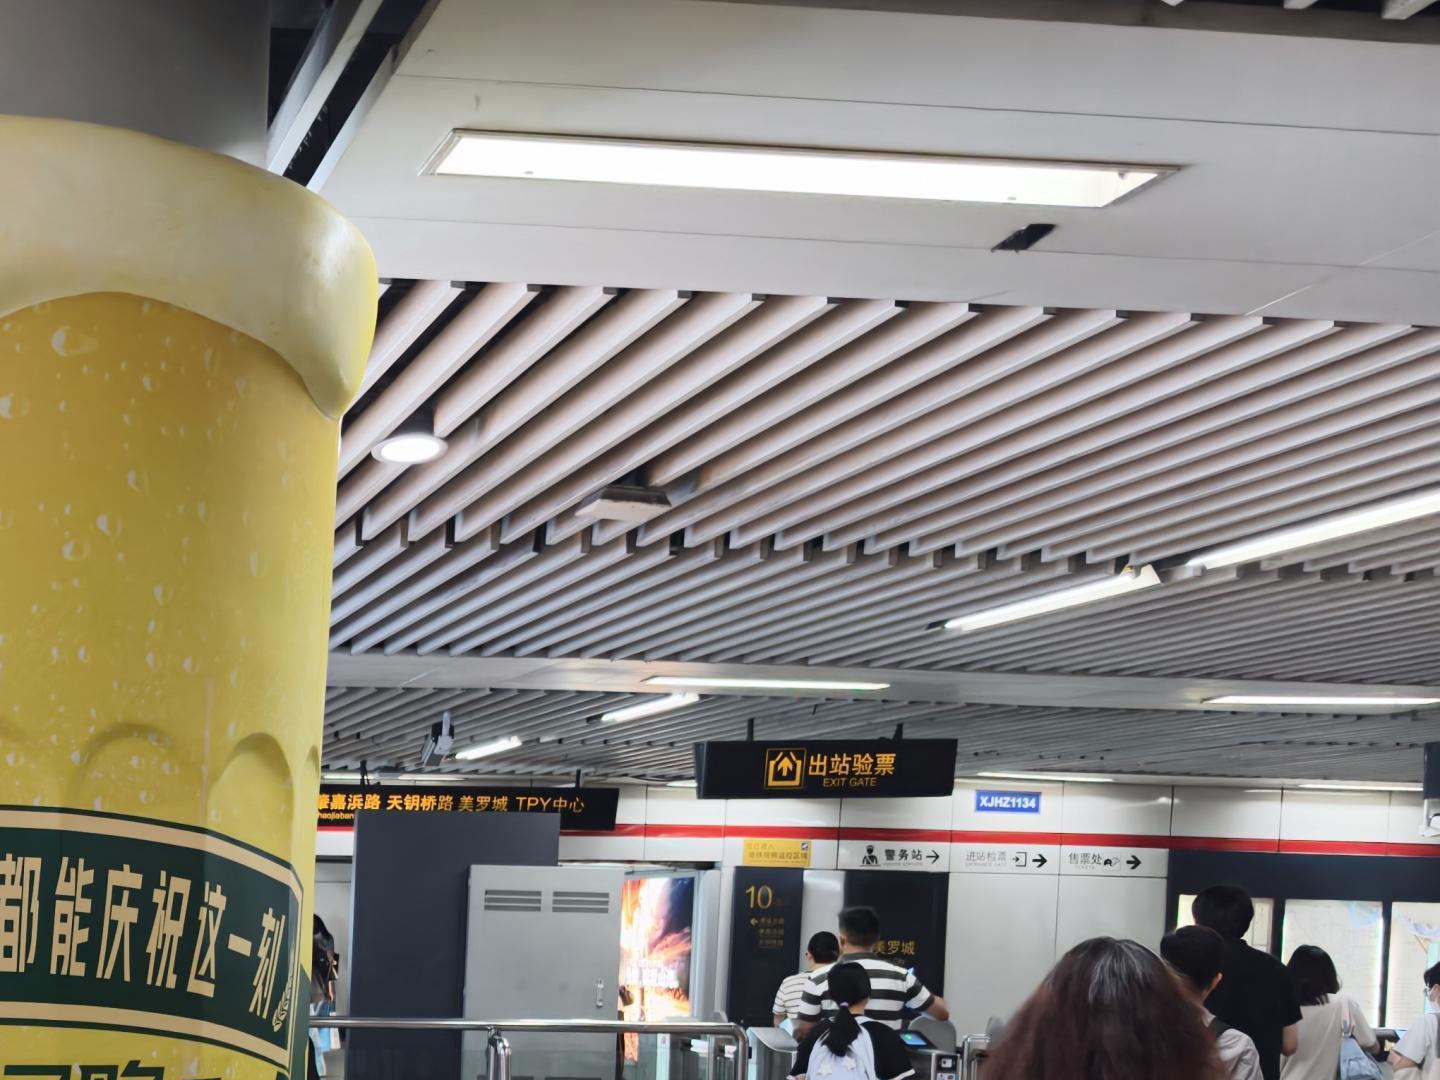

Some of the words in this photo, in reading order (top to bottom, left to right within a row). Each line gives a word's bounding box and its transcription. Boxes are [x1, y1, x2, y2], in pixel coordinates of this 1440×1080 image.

[807, 752, 897, 776] 出站验票
[823, 778, 847, 788] EXIT
[849, 777, 878, 787] GATE
[386, 794, 454, 811] 天钥桥路
[459, 796, 509, 812] 美罗城
[979, 796, 1036, 809] XJHZ1134
[884, 848, 923, 861] 警务站
[745, 884, 773, 910] 10
